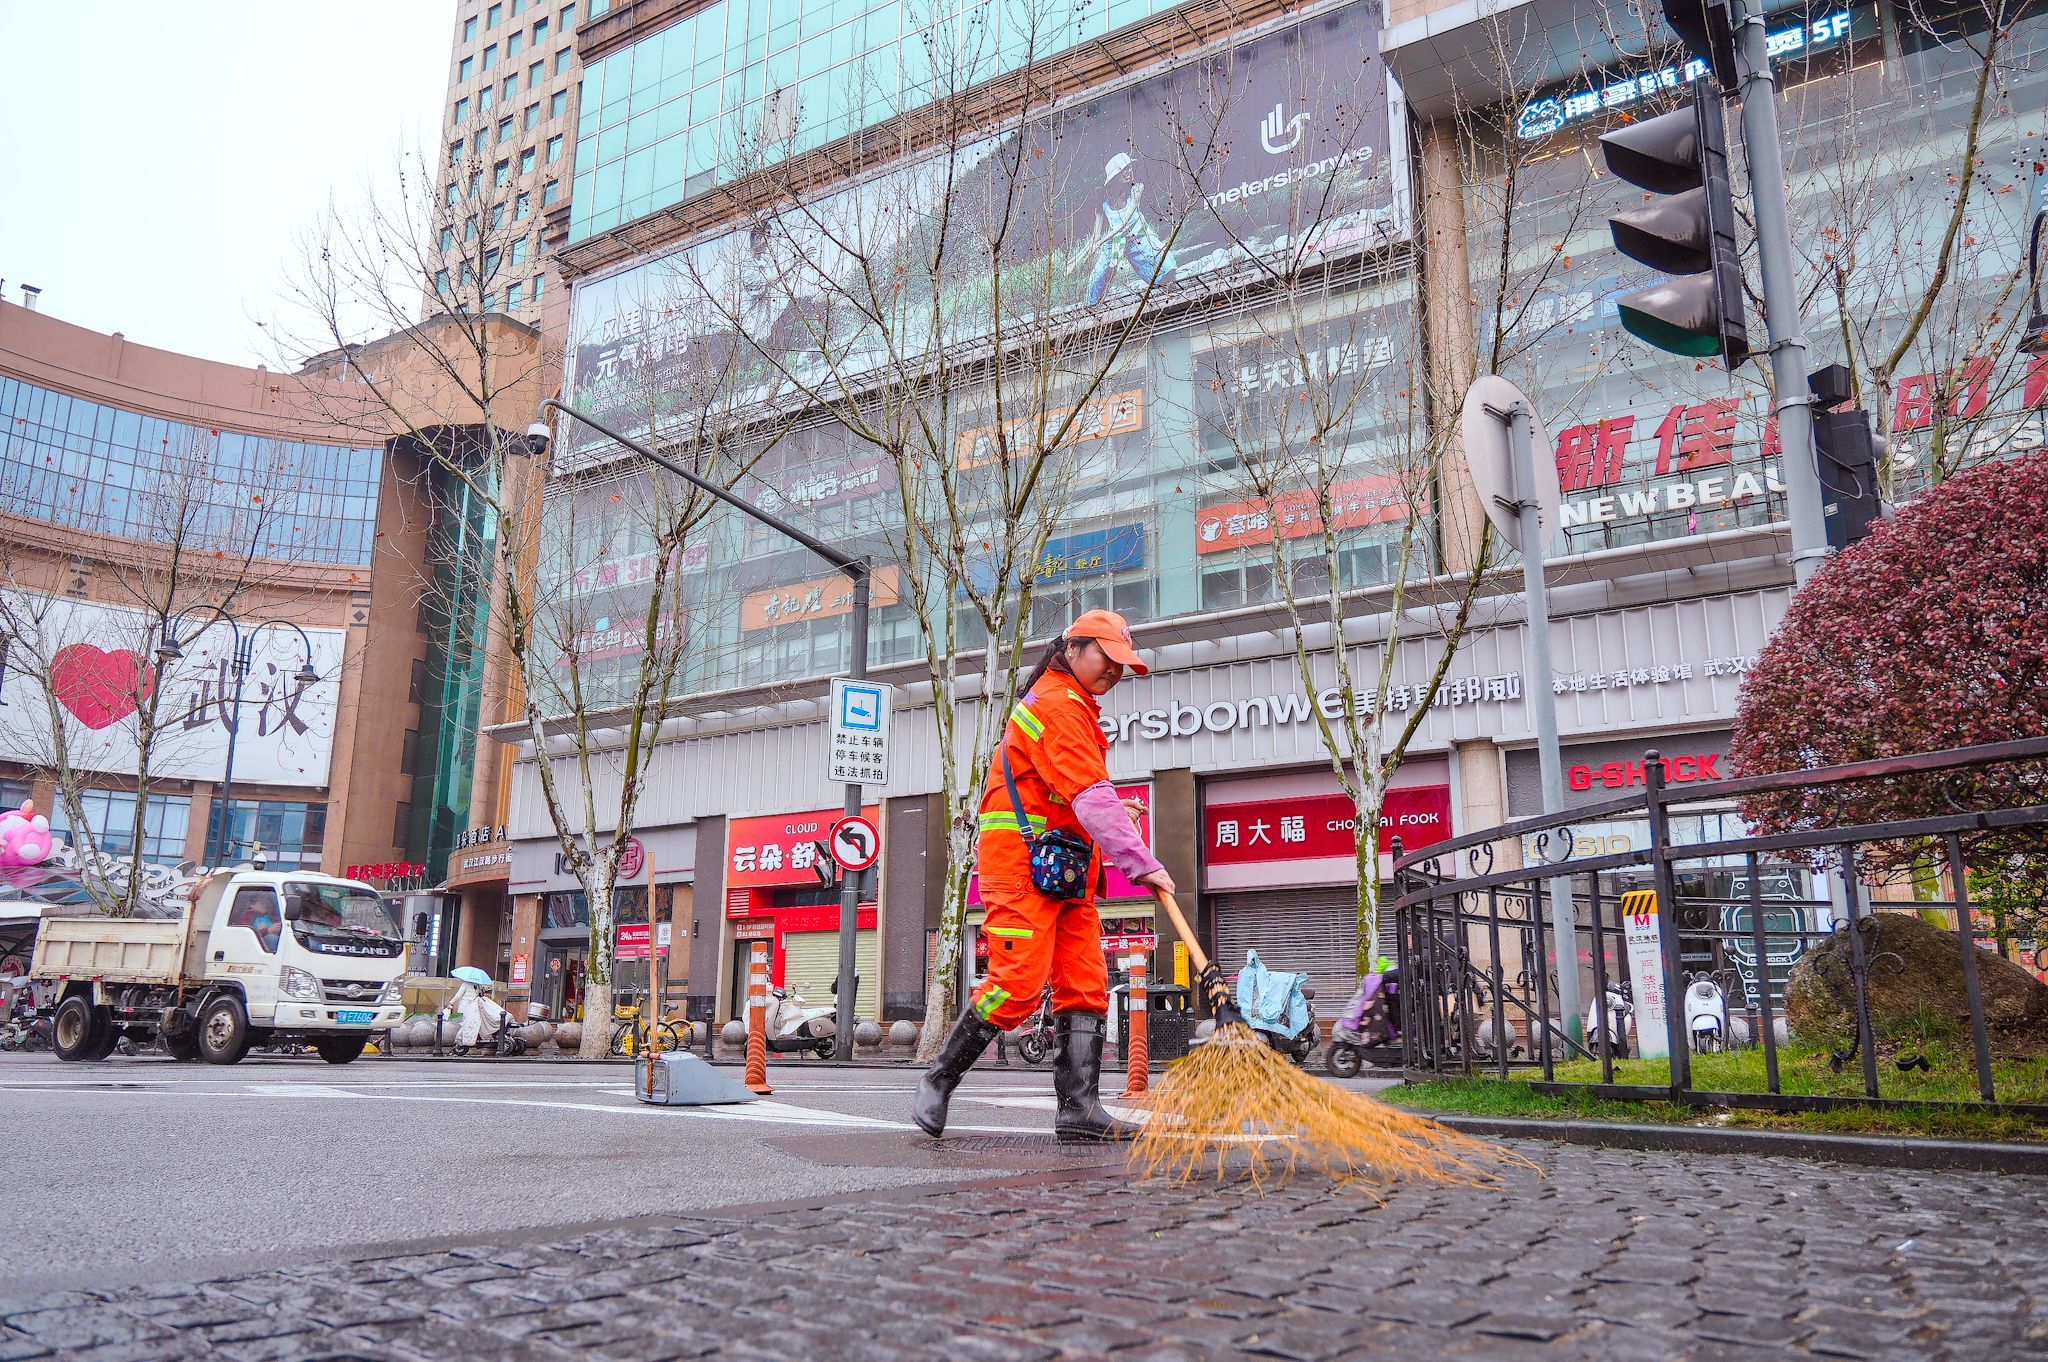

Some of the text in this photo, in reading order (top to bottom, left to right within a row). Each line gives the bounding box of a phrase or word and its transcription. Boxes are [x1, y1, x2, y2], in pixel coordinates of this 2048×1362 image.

[1812, 13, 1850, 43] 5F
[1203, 145, 1373, 210] metersbonwe
[180, 657, 310, 737] 武汉
[1098, 687, 1345, 744] ersbonwe
[1354, 671, 1521, 716] 美特斯邦威
[1552, 661, 1694, 695] 本地生活体验馆
[836, 733, 884, 748] 禁止车辆
[835, 749, 883, 764] 停车候客
[834, 765, 883, 780] 违法抓拍
[785, 822, 818, 835] CLOUD
[1215, 815, 1306, 848] 周大福
[1326, 819, 1356, 832] CHO
[1400, 812, 1440, 826] FOOK
[733, 841, 832, 873] 云朵·舒
[1528, 834, 1631, 861] CSIO
[321, 943, 390, 956] FORLAND
[1628, 934, 1658, 942] 武汉地铁
[1640, 959, 1660, 1020] 严禁施工
